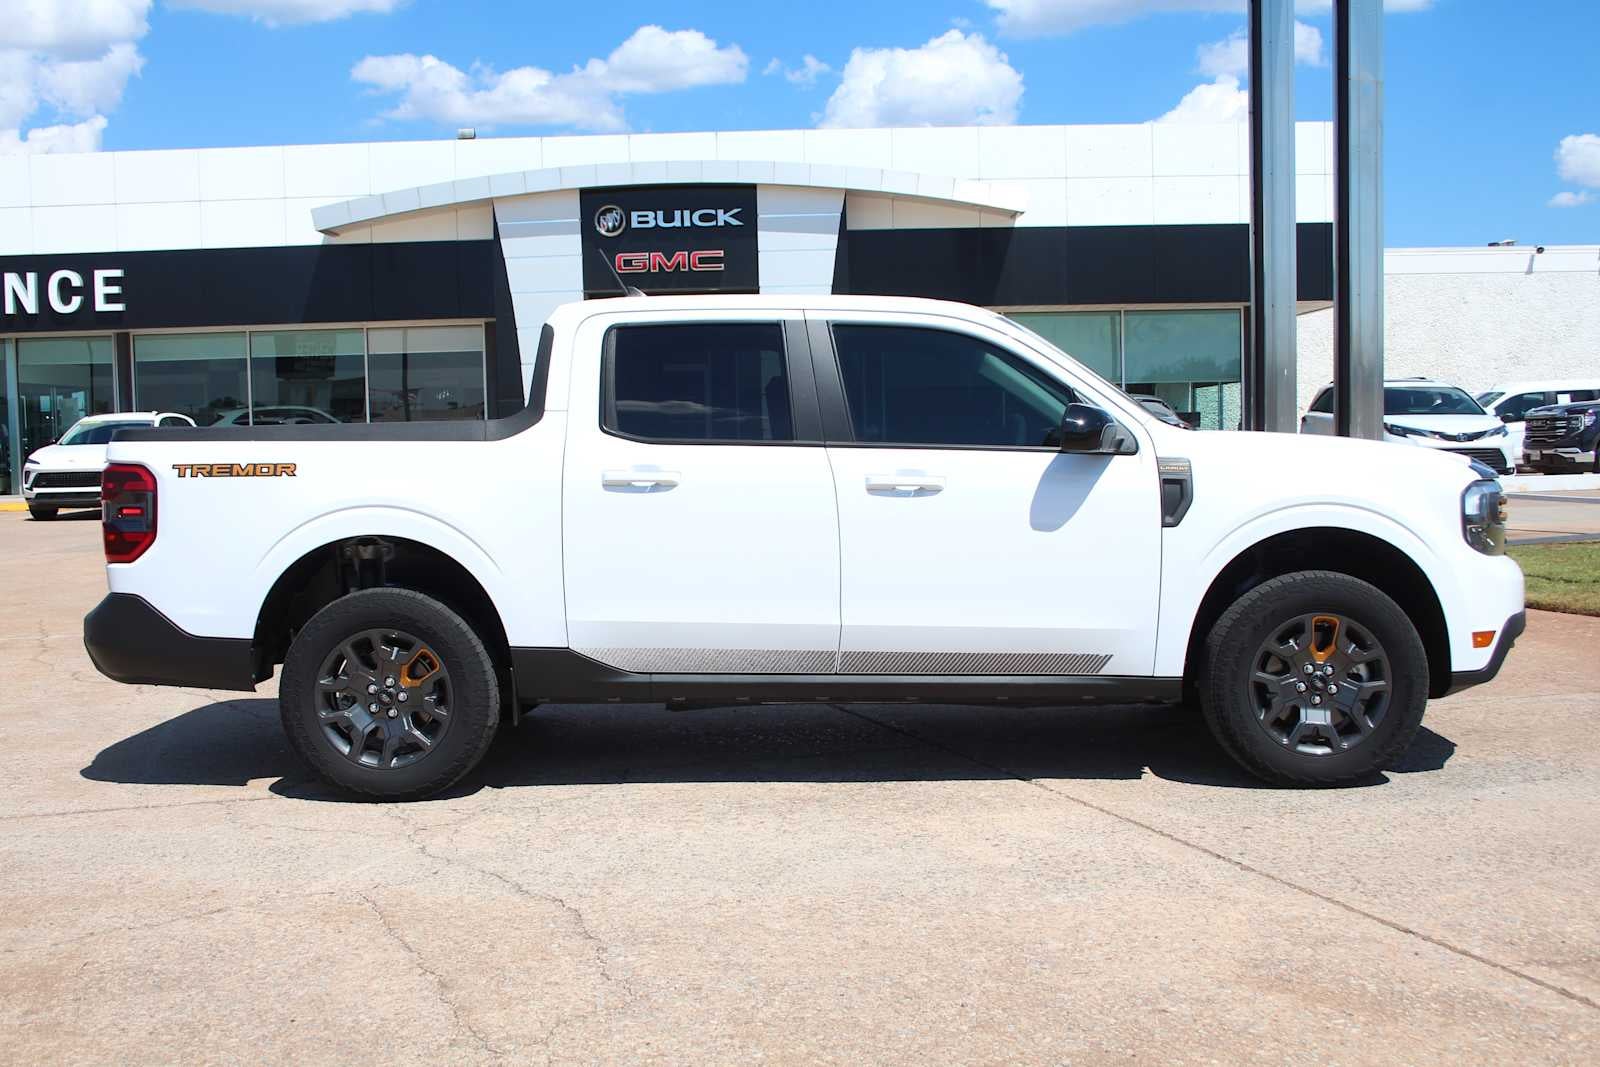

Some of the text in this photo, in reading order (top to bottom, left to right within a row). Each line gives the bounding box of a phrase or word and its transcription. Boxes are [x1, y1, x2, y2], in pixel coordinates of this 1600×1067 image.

[630, 208, 744, 229] BUICK
[615, 250, 724, 273] GMC
[3, 269, 126, 315] NCE
[172, 463, 297, 478] TREMOR
